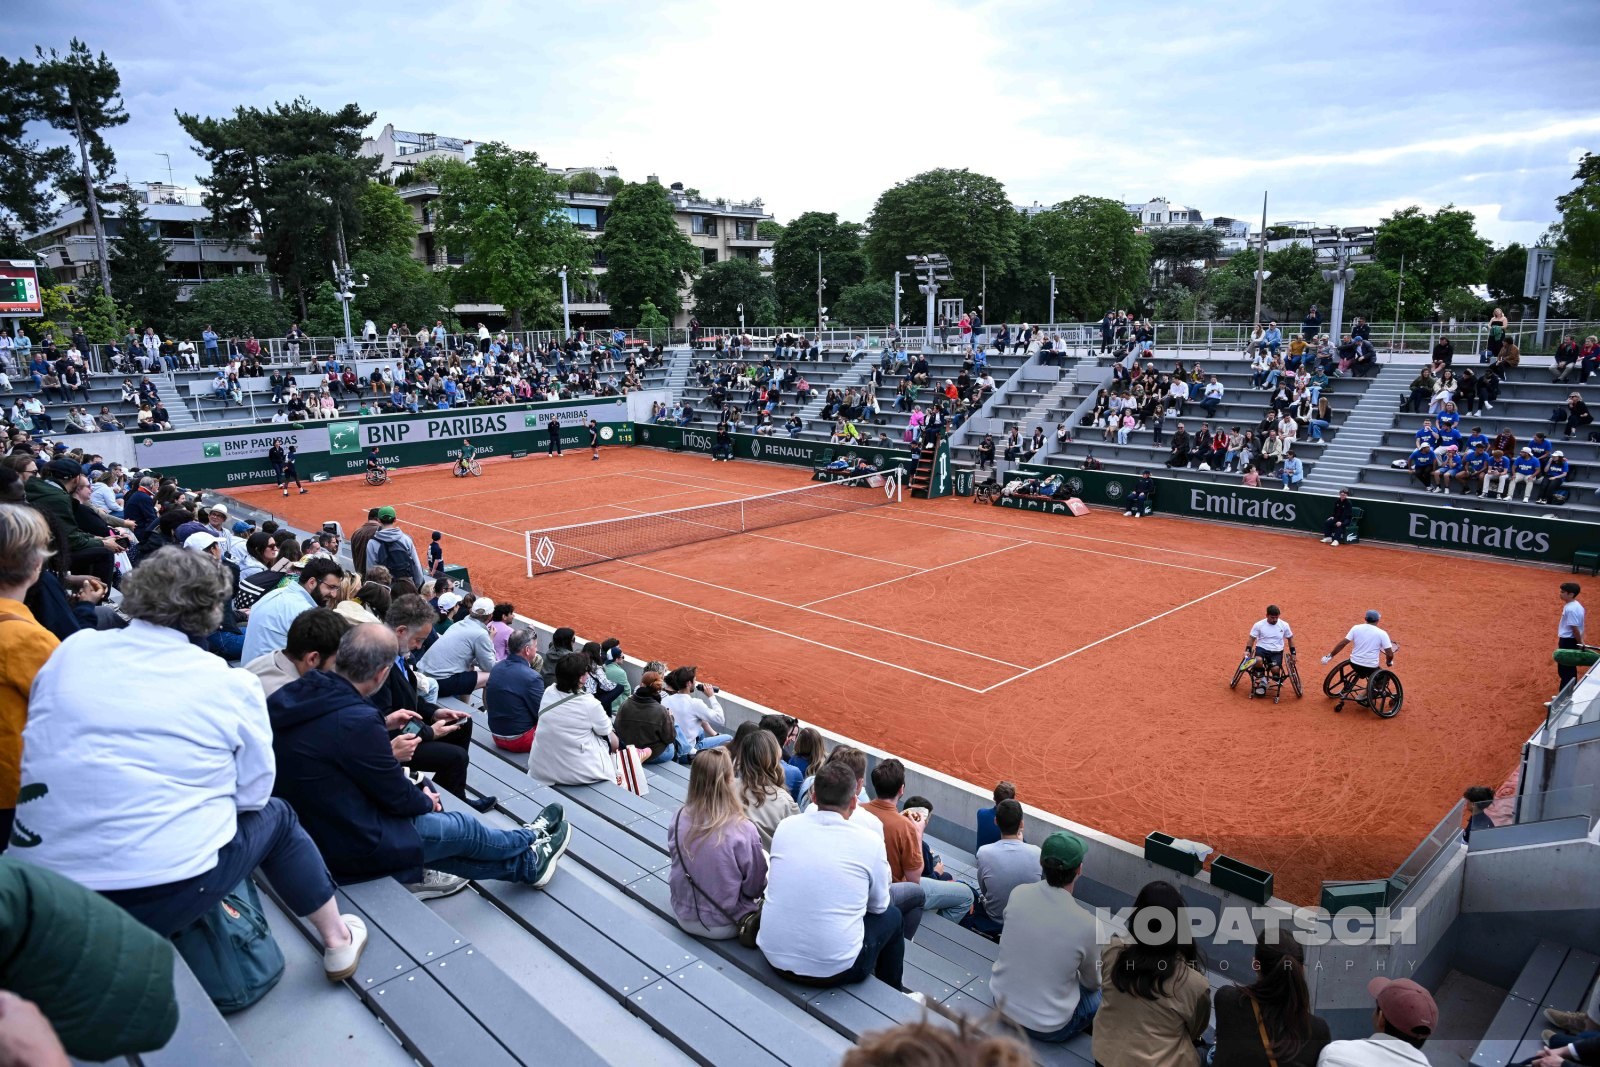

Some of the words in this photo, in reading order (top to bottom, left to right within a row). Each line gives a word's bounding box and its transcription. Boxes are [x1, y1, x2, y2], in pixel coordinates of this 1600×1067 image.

[540, 412, 554, 422] BNP
[556, 410, 588, 420] PARIBAS
[368, 423, 410, 444] BNP
[428, 415, 506, 438] PARIBAS
[224, 440, 248, 450] BNP
[682, 430, 712, 450] Infosys
[766, 444, 812, 459] RENAULT
[347, 460, 364, 468] BNP
[366, 456, 400, 465] RIBAS
[228, 472, 246, 481] BNP
[250, 469, 277, 478] PARIB
[1190, 488, 1296, 522] Emirates
[1409, 512, 1550, 553] Emirates
